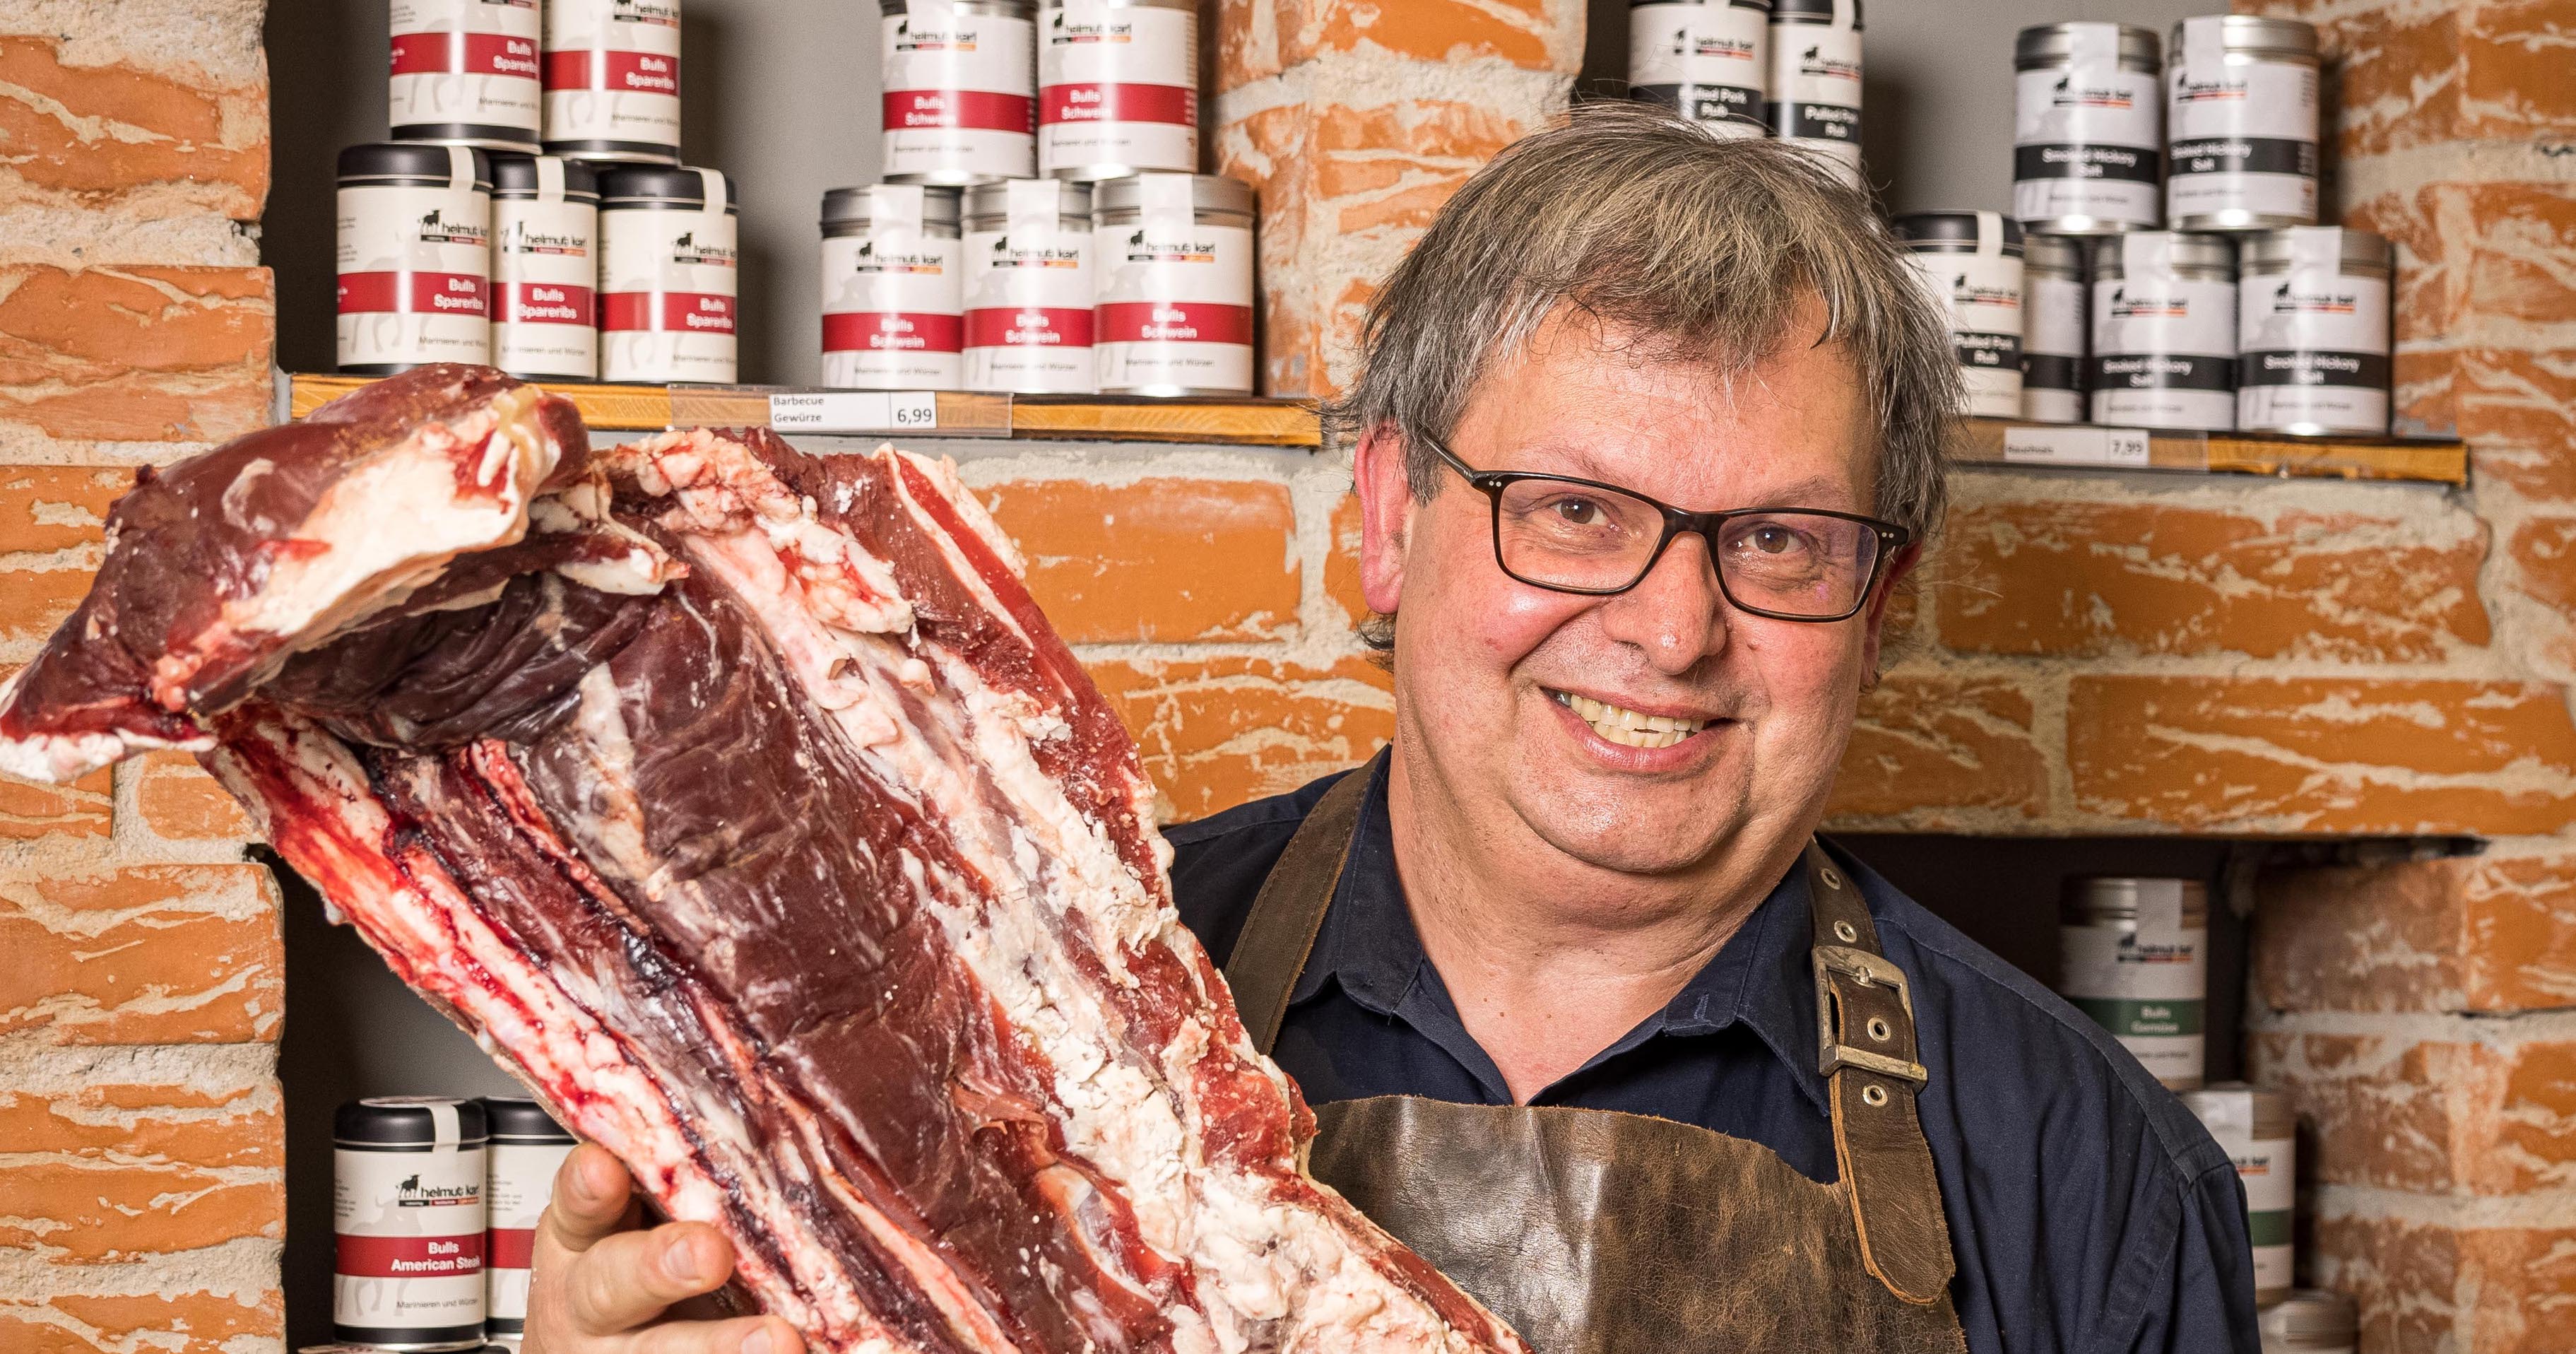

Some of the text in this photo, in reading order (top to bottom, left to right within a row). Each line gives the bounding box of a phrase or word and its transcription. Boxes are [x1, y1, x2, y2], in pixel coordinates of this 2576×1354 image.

[507, 40, 531, 56] Bulls
[492, 55, 538, 73] Spareribs
[640, 57, 668, 73] Bulls
[626, 71, 675, 90] Spareribs
[914, 96, 945, 110] Bulls
[1070, 89, 1101, 103] Bulls
[905, 112, 957, 125] Schwein
[1061, 106, 1112, 119] Schwein
[1194, 242, 1215, 253] karl
[448, 278, 475, 293] Bulls
[433, 293, 484, 310] Spareribs
[533, 288, 565, 302] Bulls
[519, 303, 577, 319] Spareribs
[699, 298, 726, 312] Bulls
[686, 312, 733, 329] Spareribs
[1015, 313, 1049, 328] Bulls
[1152, 309, 1186, 322] Bulls
[880, 319, 914, 333] Bulls
[1141, 324, 1198, 338] Schwein
[870, 334, 926, 348] Schwein
[1005, 329, 1060, 343] Schwein
[774, 395, 825, 406] Barbecue
[774, 411, 822, 423] Gewürze
[897, 408, 932, 425] 6,99
[421, 1186, 463, 1197] helmut
[428, 1241, 459, 1254] Bulls
[391, 1255, 480, 1271] American Steak
